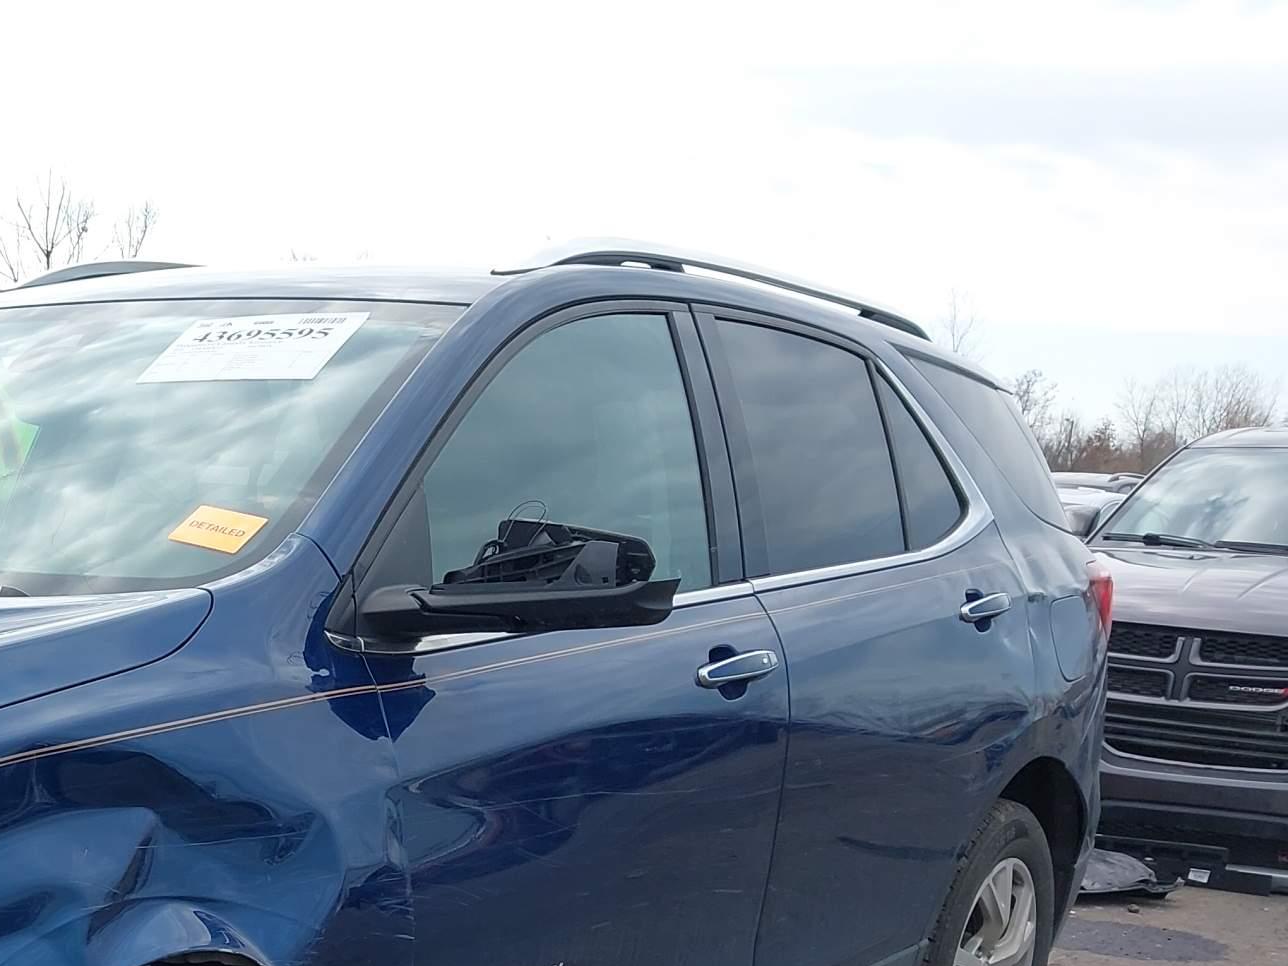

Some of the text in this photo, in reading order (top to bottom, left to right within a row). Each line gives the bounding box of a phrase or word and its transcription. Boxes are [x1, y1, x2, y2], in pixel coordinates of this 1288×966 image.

[193, 327, 334, 342] 43695595
[188, 520, 246, 537] DETAILED
[1228, 685, 1281, 693] DODGE
